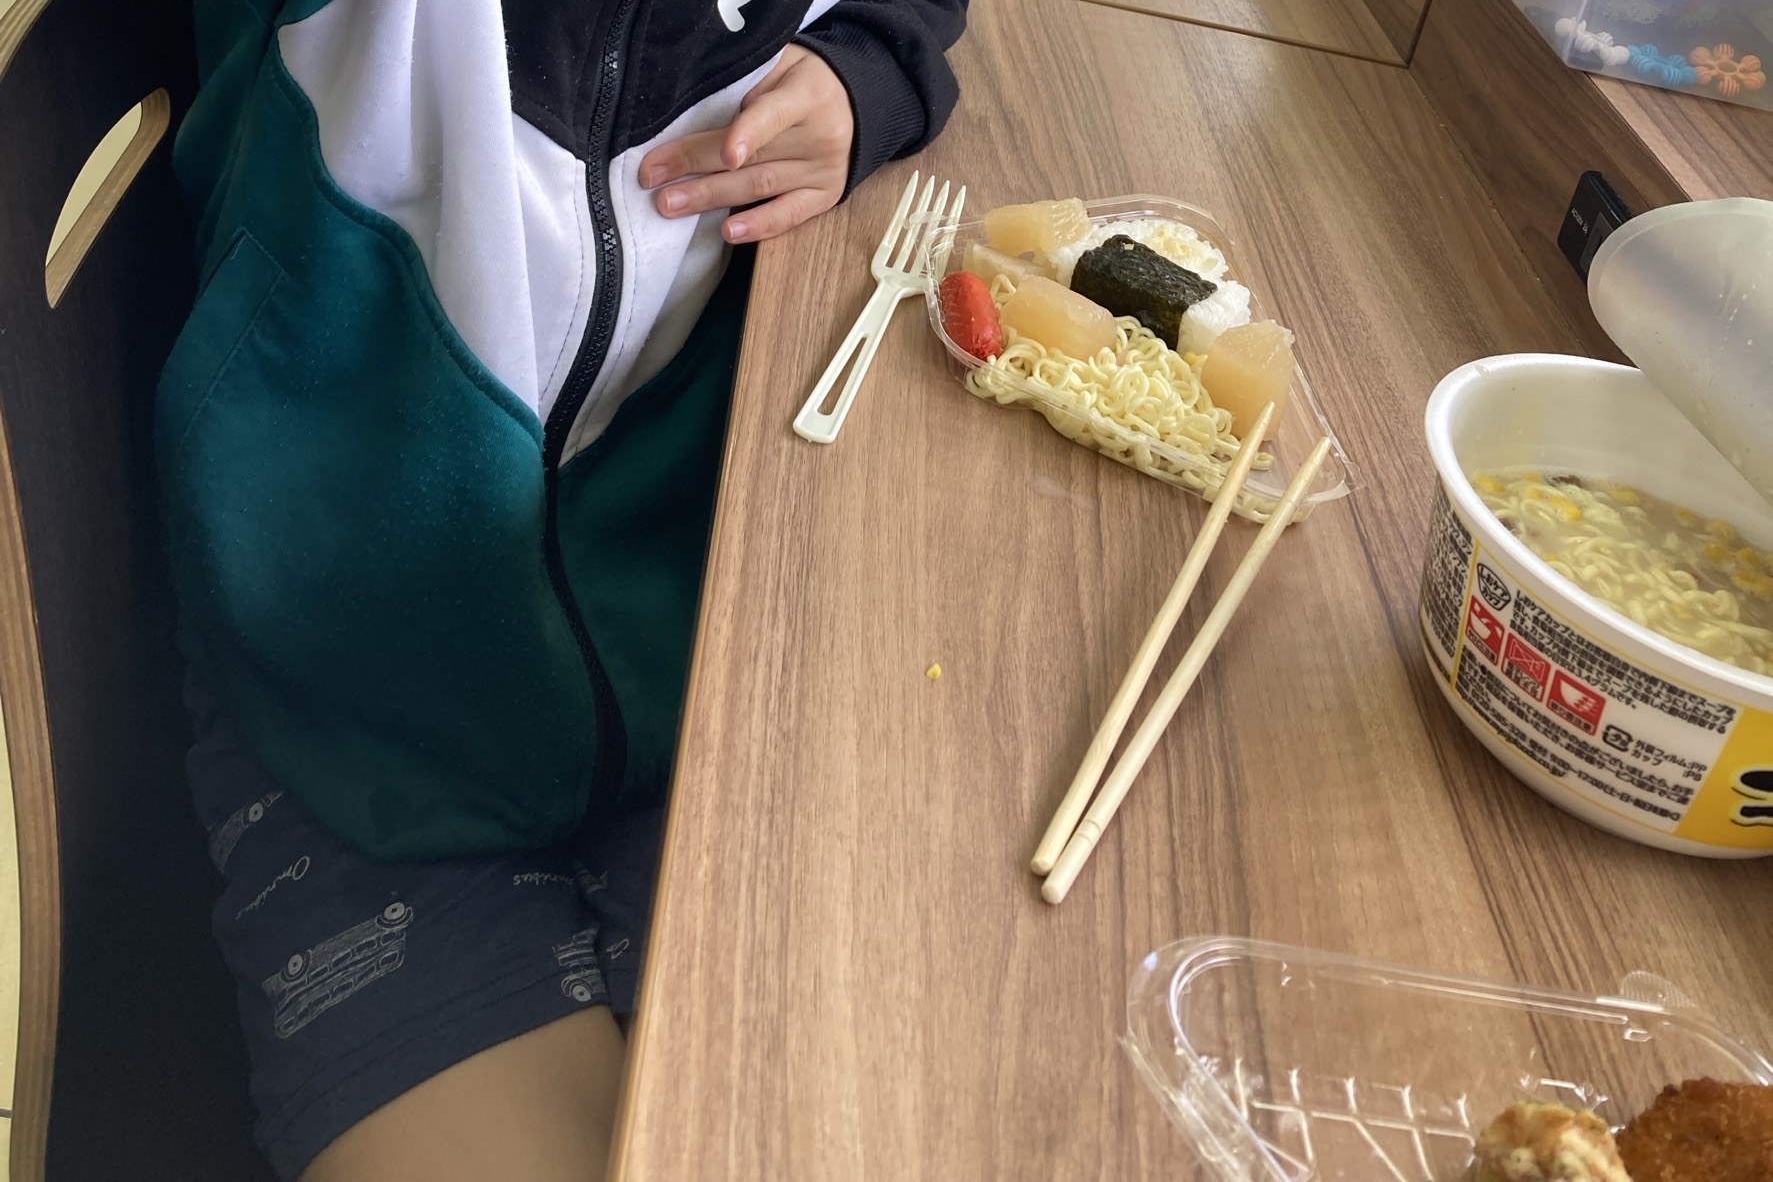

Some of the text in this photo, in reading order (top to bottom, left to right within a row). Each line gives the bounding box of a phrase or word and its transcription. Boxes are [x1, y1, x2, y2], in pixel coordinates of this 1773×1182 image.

[1481, 566, 1508, 597] しおケア
[1482, 586, 1501, 606] カップ
[1631, 749, 1662, 766] カップ
